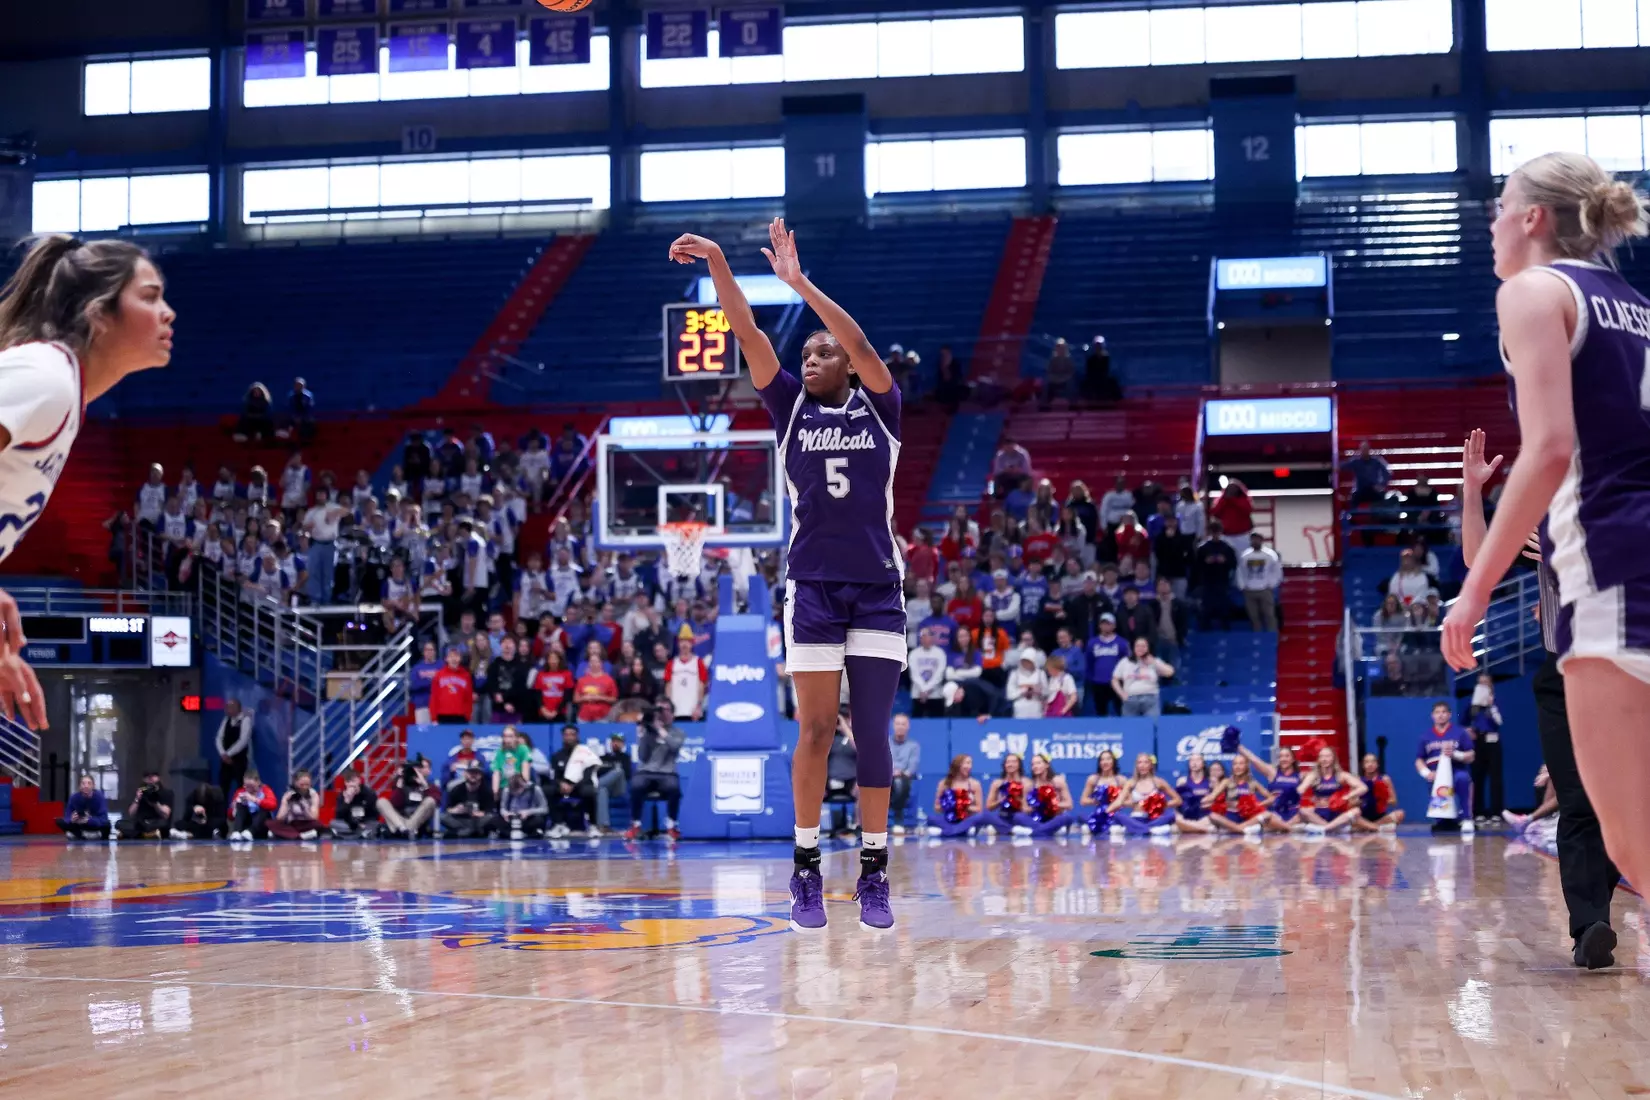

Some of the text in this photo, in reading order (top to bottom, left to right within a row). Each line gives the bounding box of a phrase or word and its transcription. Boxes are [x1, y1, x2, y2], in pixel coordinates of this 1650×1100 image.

[545, 30, 575, 53] 45
[662, 24, 692, 47] 22
[742, 22, 758, 45] 0
[332, 41, 361, 63] 25
[478, 34, 493, 57] 4
[406, 128, 433, 149] 10
[1241, 136, 1269, 161] 12
[815, 153, 835, 177] 11
[1591, 294, 1650, 340] CLAESS
[678, 332, 725, 372] 22
[798, 427, 877, 453] Wildcats
[825, 457, 851, 499] 5
[1032, 738, 1124, 760] Kansas
